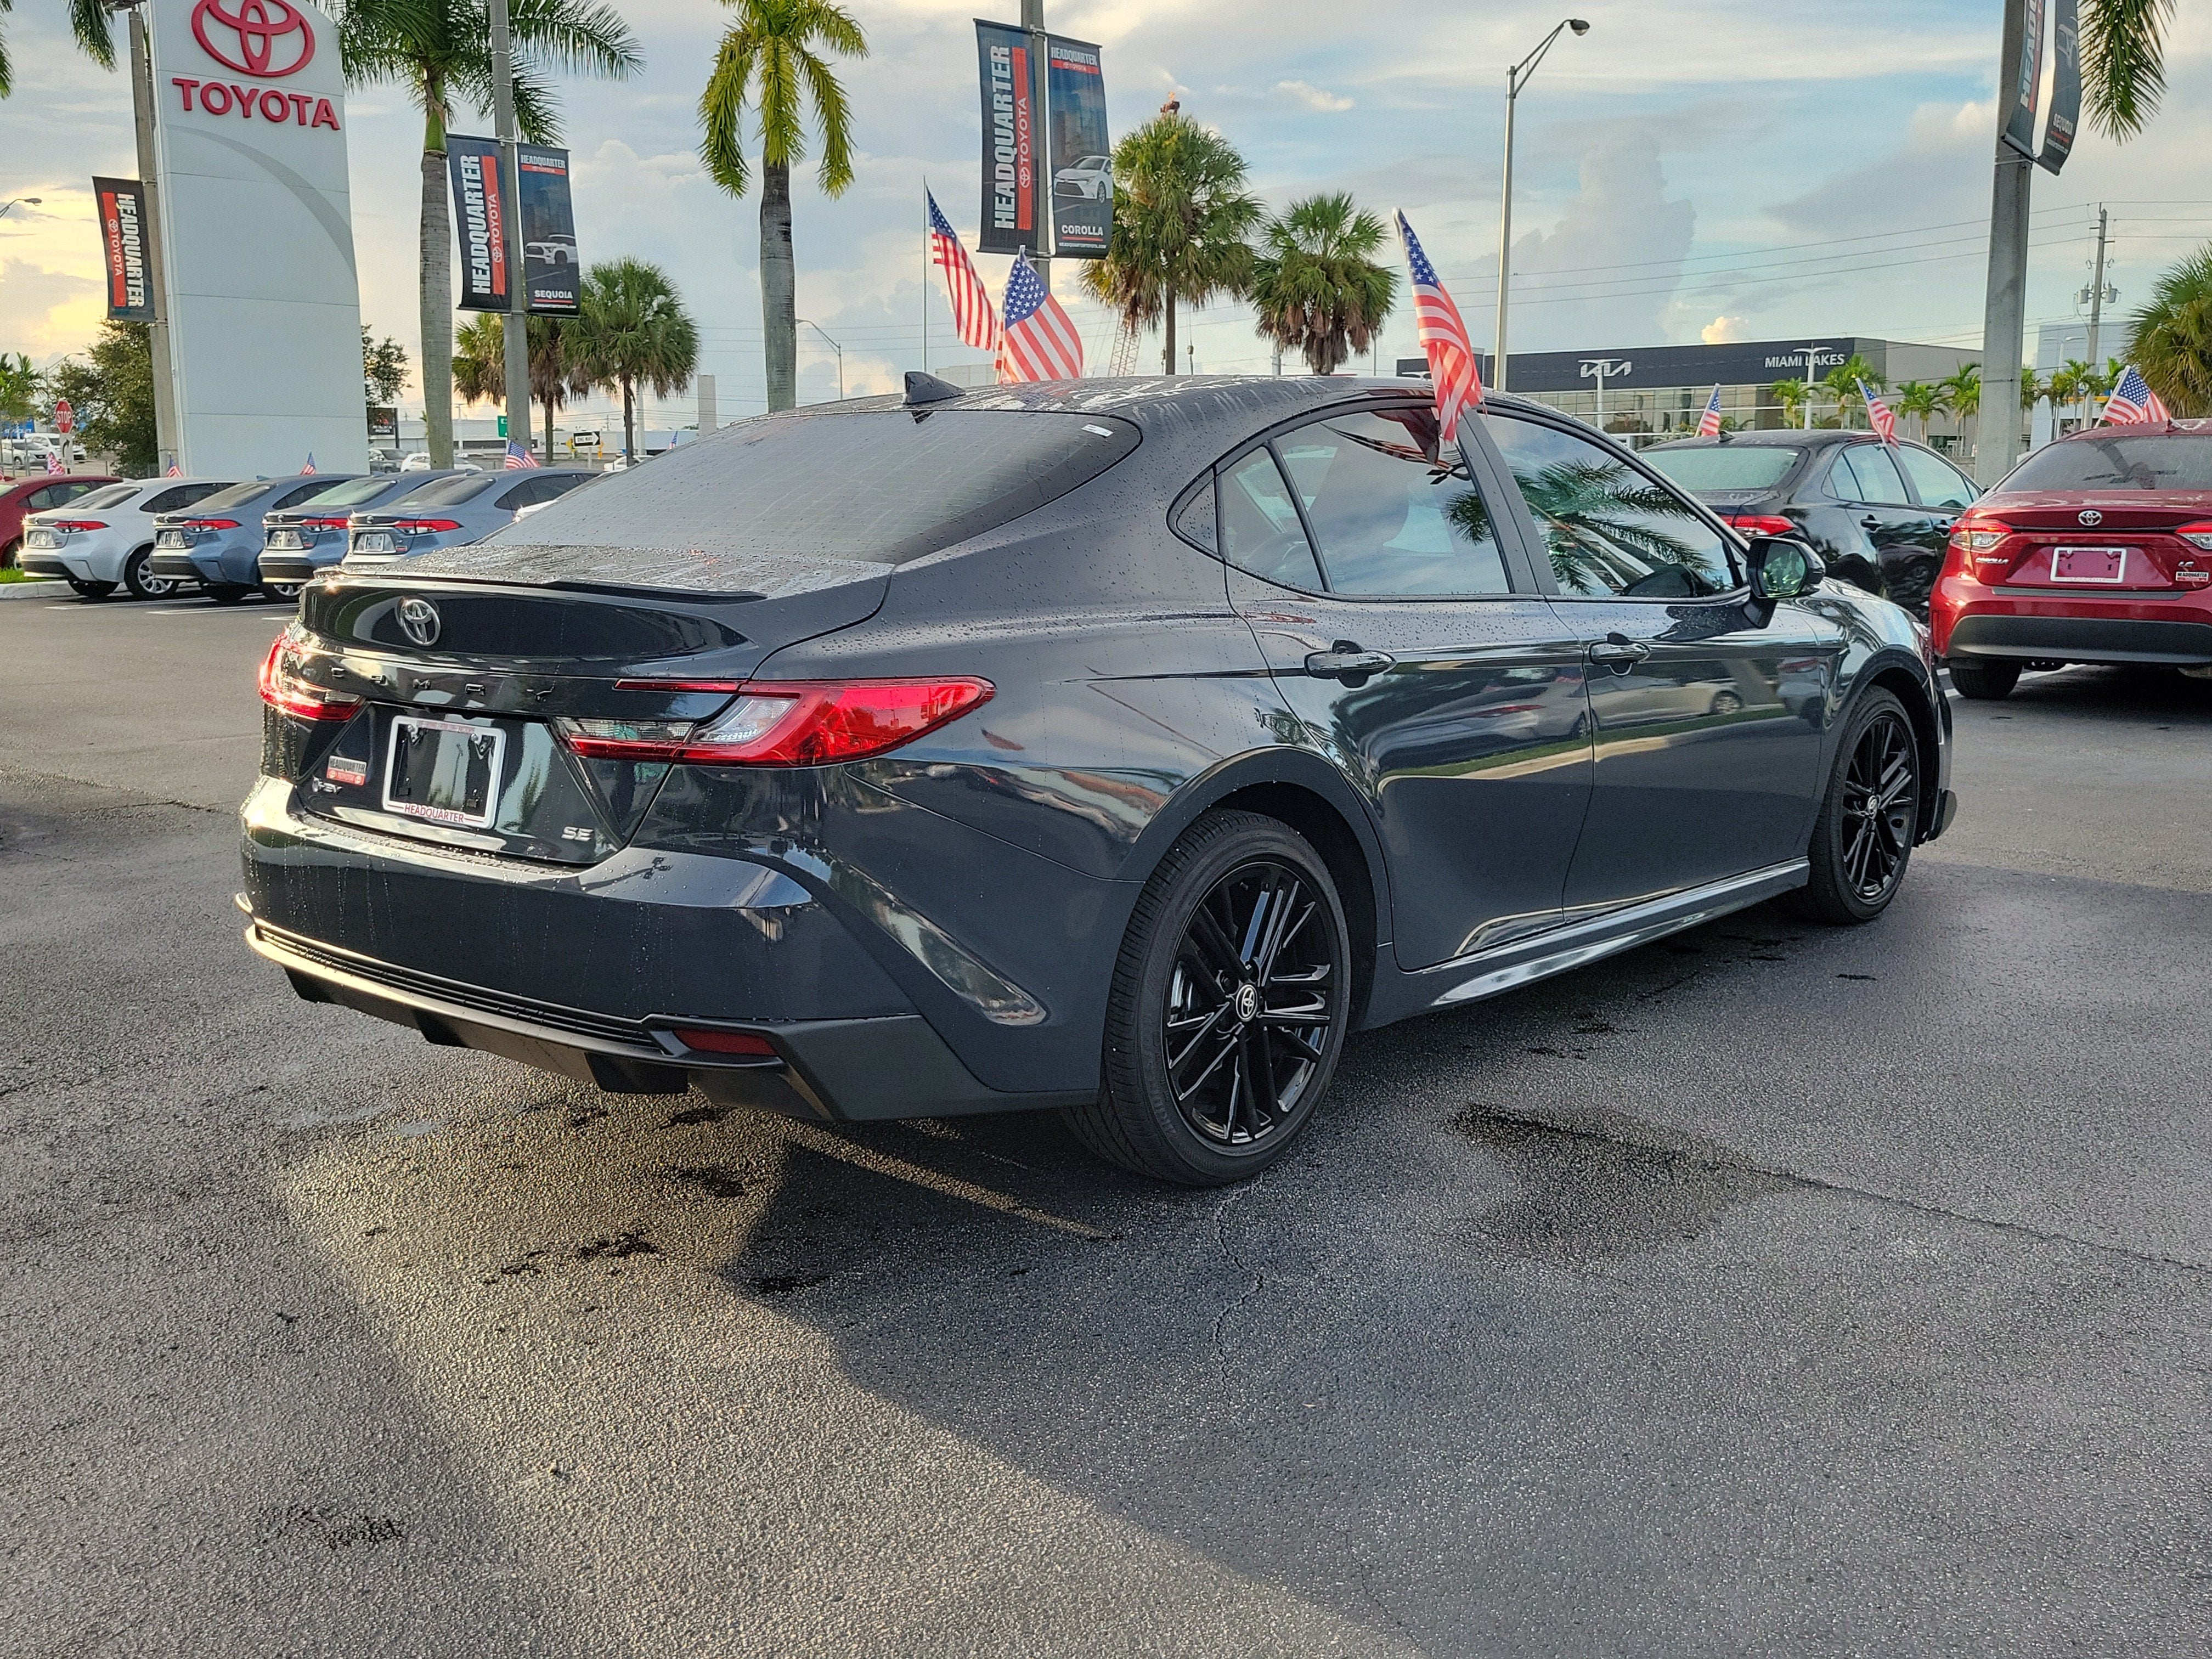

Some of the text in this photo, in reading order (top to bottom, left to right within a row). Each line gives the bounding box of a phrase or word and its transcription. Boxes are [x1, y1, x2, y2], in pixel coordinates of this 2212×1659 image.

[1051, 47, 1097, 66] HEADQUARTER
[172, 77, 341, 131] TOYOTA
[990, 46, 1016, 229] HEADQUARTER
[1018, 97, 1029, 165] TOYOTA
[521, 154, 565, 168] HEADQUARTER
[460, 155, 490, 294] HEADQUARTER
[488, 194, 500, 245] TOYOTA
[1062, 225, 1103, 236] COROLLA
[111, 234, 123, 276] TOYOTA
[116, 193, 145, 307] HEADQUARTER
[534, 289, 573, 299] SEQUOIA
[1765, 354, 1844, 368] MIAMI LAKES
[57, 411, 71, 424] STOP
[330, 758, 365, 774] HEADQUARTER
[405, 803, 464, 823] HEADQUARTER
[561, 826, 594, 842] SE
